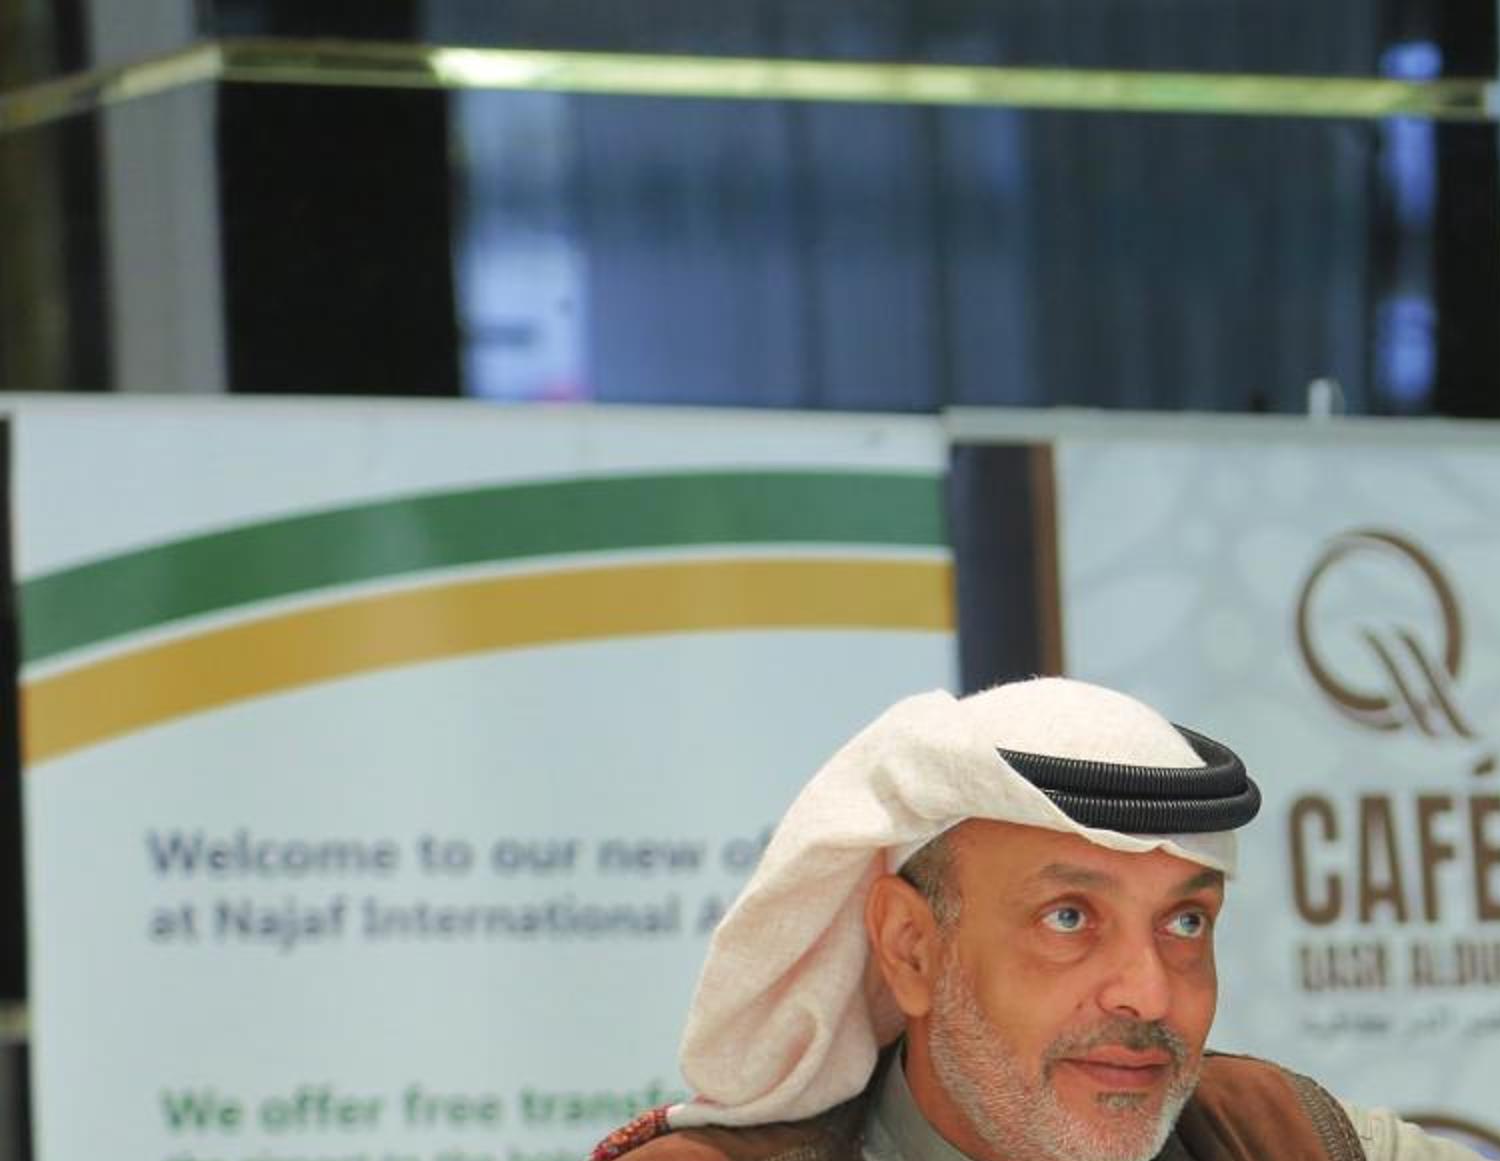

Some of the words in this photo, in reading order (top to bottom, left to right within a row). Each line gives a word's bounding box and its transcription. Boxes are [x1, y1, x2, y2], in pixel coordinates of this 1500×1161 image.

[148, 828, 394, 877] Welcome
[417, 833, 473, 877] to
[494, 836, 578, 877] our
[599, 836, 705, 876] new
[149, 904, 197, 940] at
[212, 896, 346, 952] Najaf
[362, 896, 680, 940] International
[159, 1087, 242, 1133] We
[257, 1083, 384, 1132] offer
[403, 1081, 500, 1130] free
